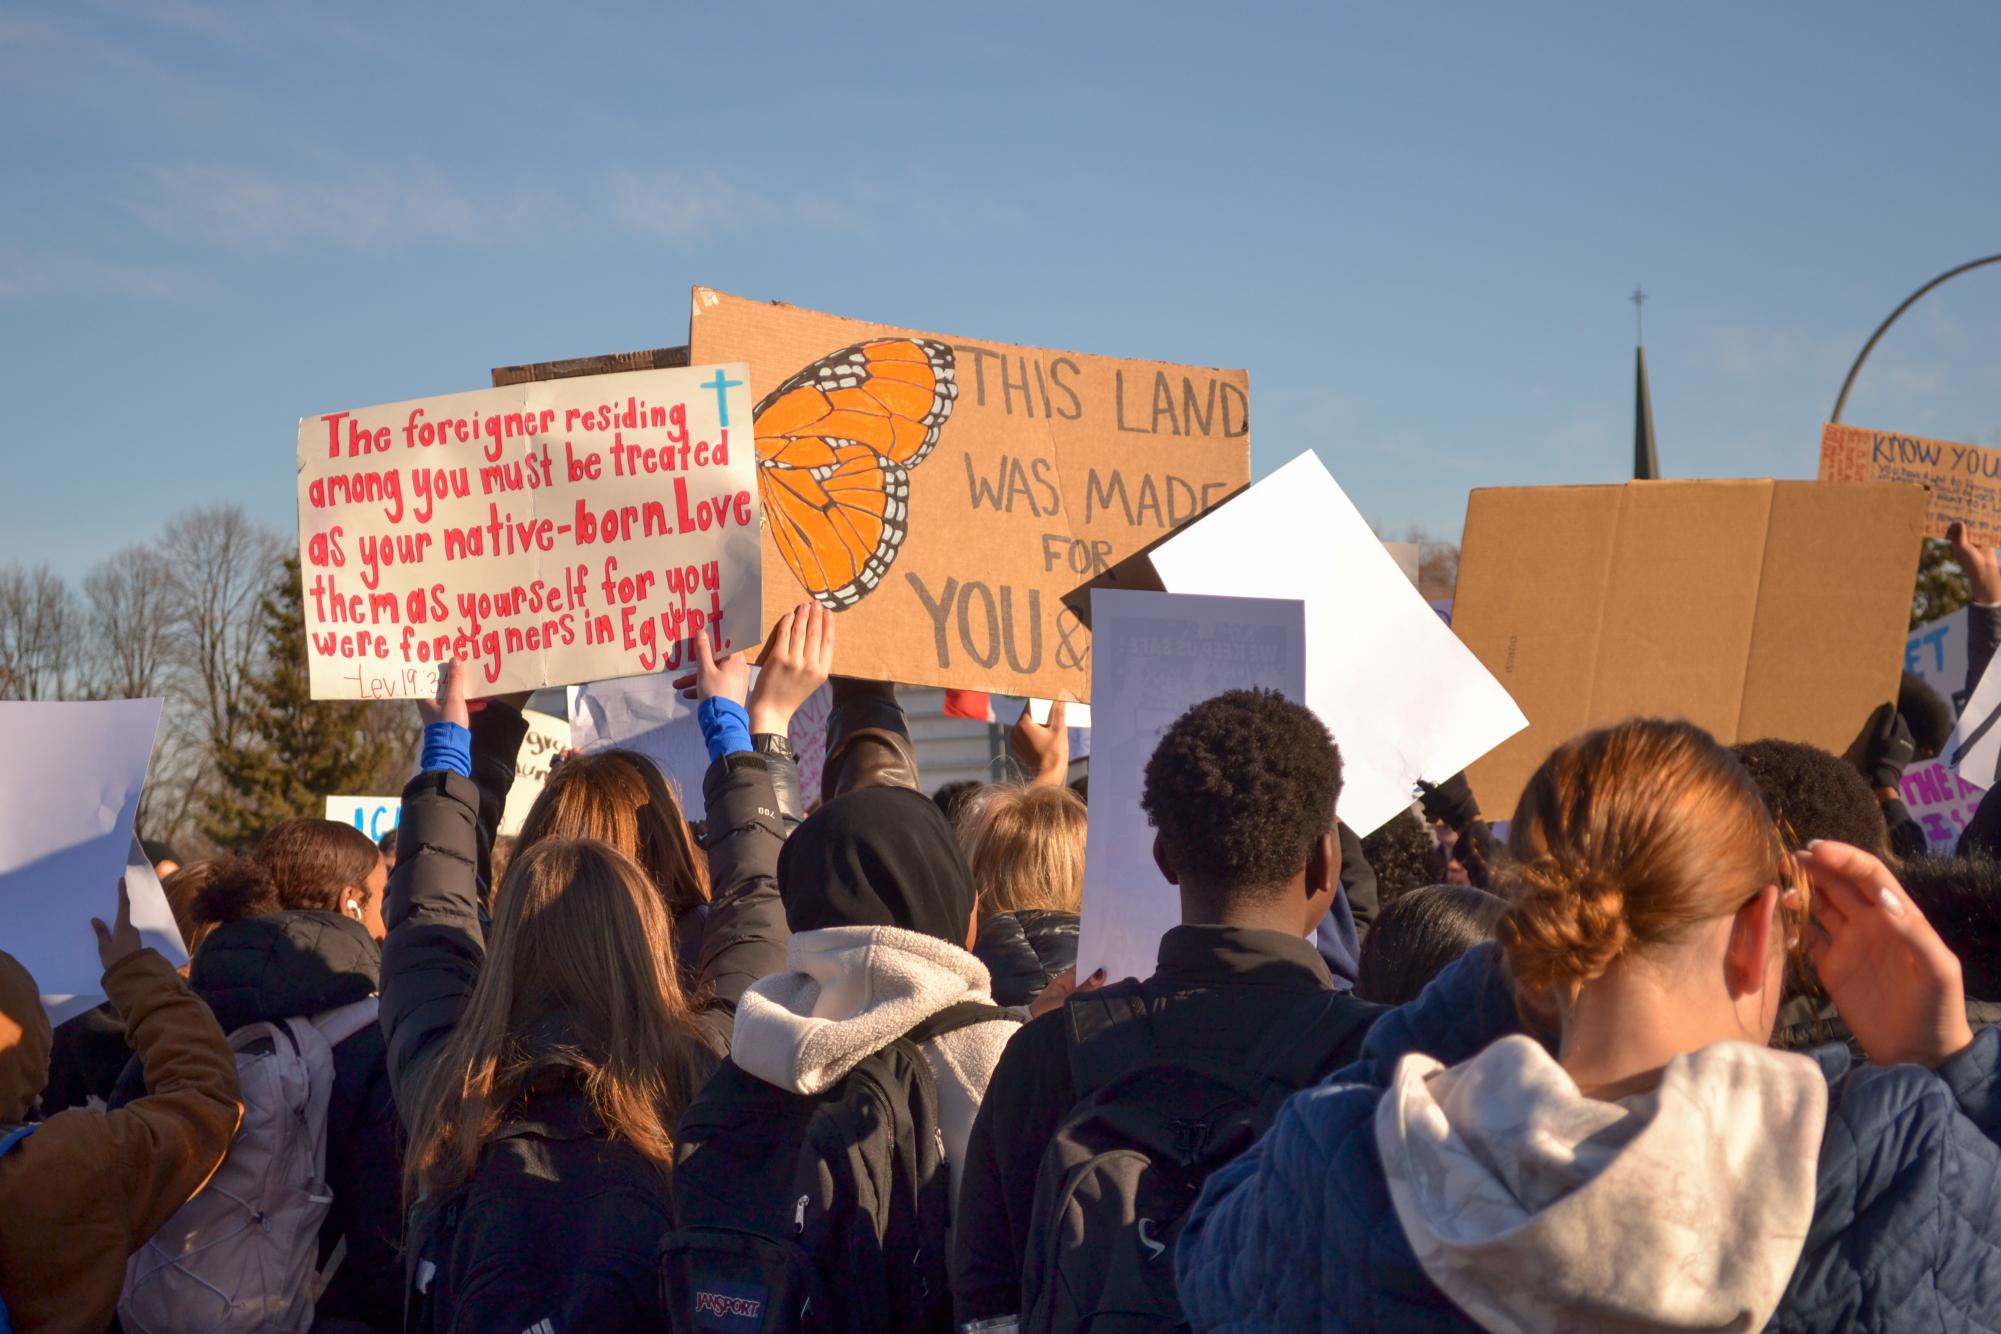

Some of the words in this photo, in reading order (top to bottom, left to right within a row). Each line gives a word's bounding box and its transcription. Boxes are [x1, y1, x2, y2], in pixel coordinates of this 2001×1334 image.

[954, 344, 1082, 421] THIS
[1116, 368, 1249, 438] LAND
[321, 411, 391, 457] The
[402, 408, 555, 462] foreigner
[565, 397, 687, 443] residing
[308, 464, 401, 524] among
[412, 461, 470, 523] you
[480, 447, 553, 496] must
[567, 441, 601, 482] be
[610, 428, 728, 476] treated
[964, 452, 1059, 517] WAS
[308, 525, 345, 568] as
[359, 529, 432, 590] your
[1042, 534, 1116, 580] FOR
[310, 574, 399, 625] them
[406, 583, 449, 624] as
[457, 563, 590, 641] yourself
[601, 556, 655, 605] for
[666, 560, 720, 623] you
[904, 570, 1042, 675] YOU
[1055, 605, 1089, 673] &
[312, 630, 389, 658] were
[401, 613, 574, 684] foreigners
[584, 606, 612, 647] in
[621, 592, 731, 671] Egypt.
[1899, 763, 1953, 806] THE
[354, 805, 402, 843] IC
[696, 1291, 760, 1319] JANSPORT
